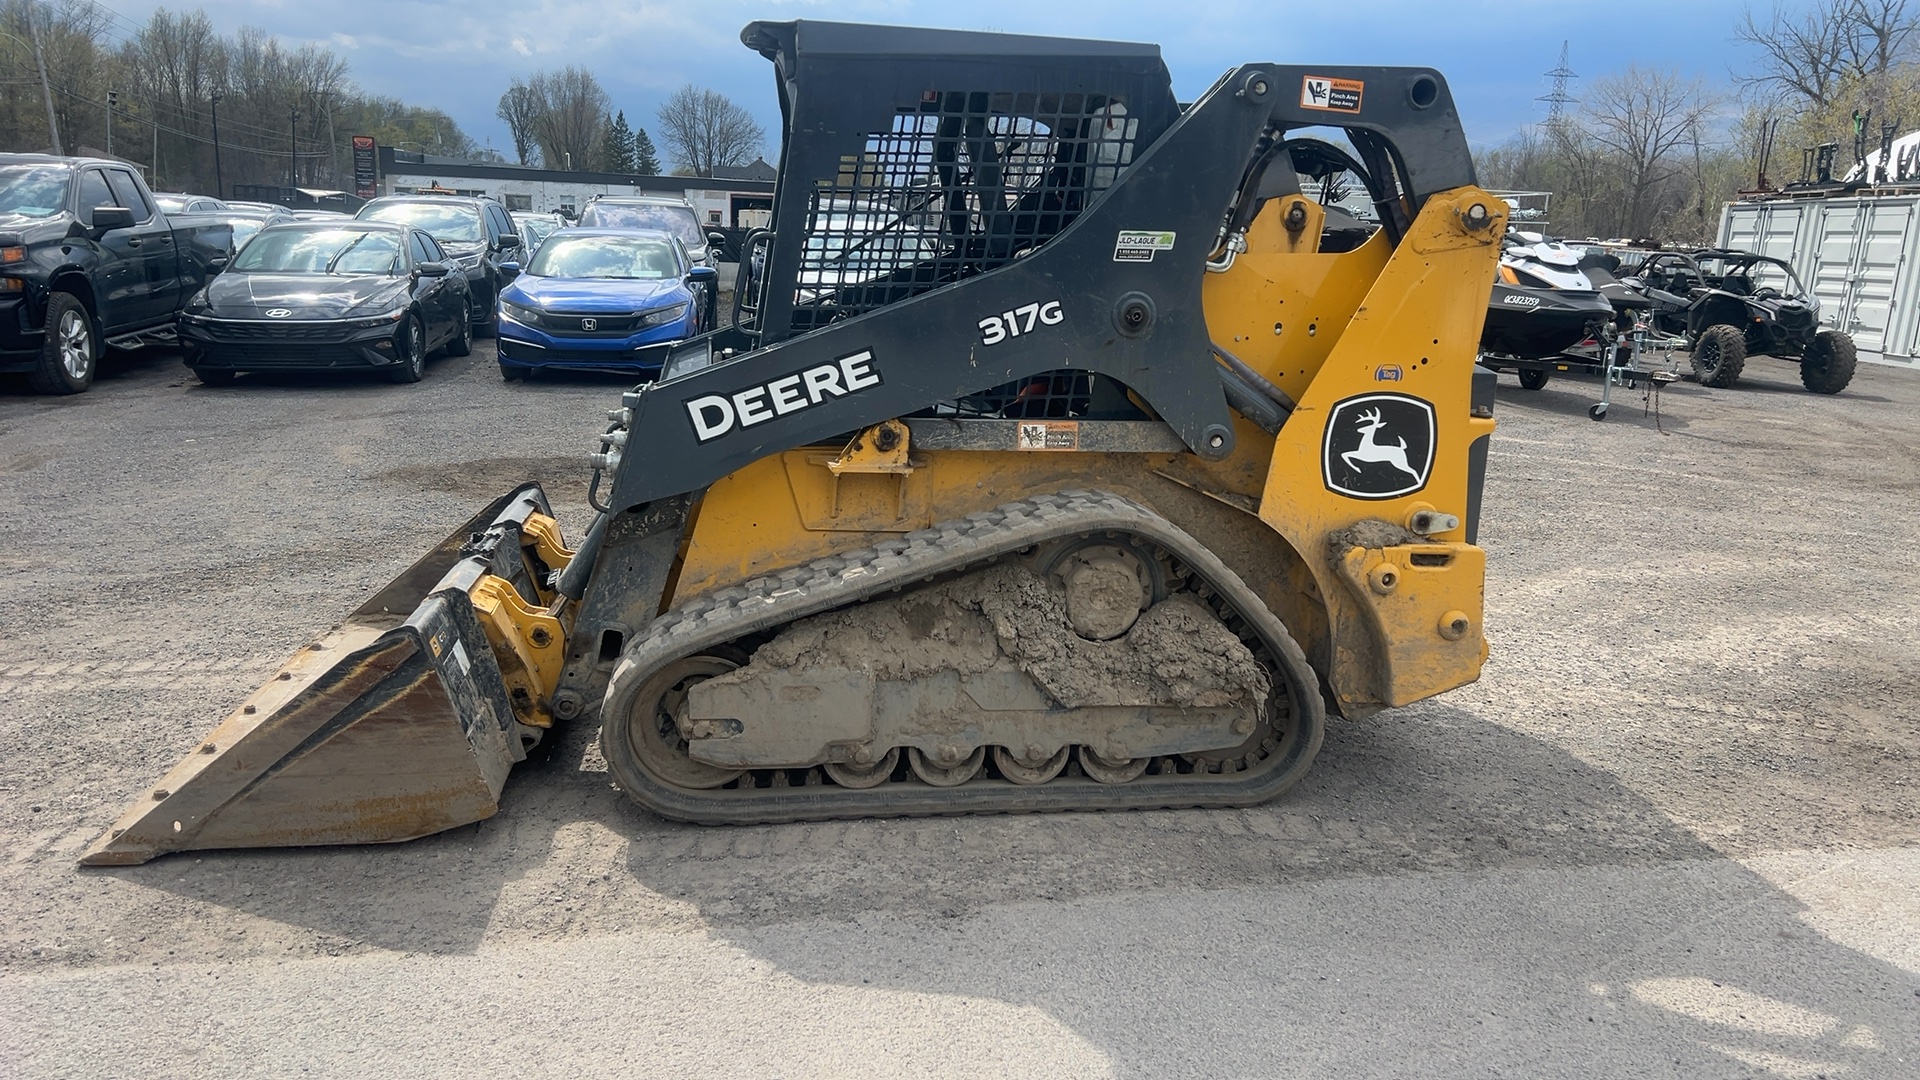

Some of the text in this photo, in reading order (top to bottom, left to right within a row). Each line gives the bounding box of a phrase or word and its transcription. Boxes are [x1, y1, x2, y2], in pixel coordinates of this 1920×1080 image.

[978, 300, 1064, 345] 317G
[686, 350, 880, 442] DEERE
[1382, 370, 1396, 379] Tag
